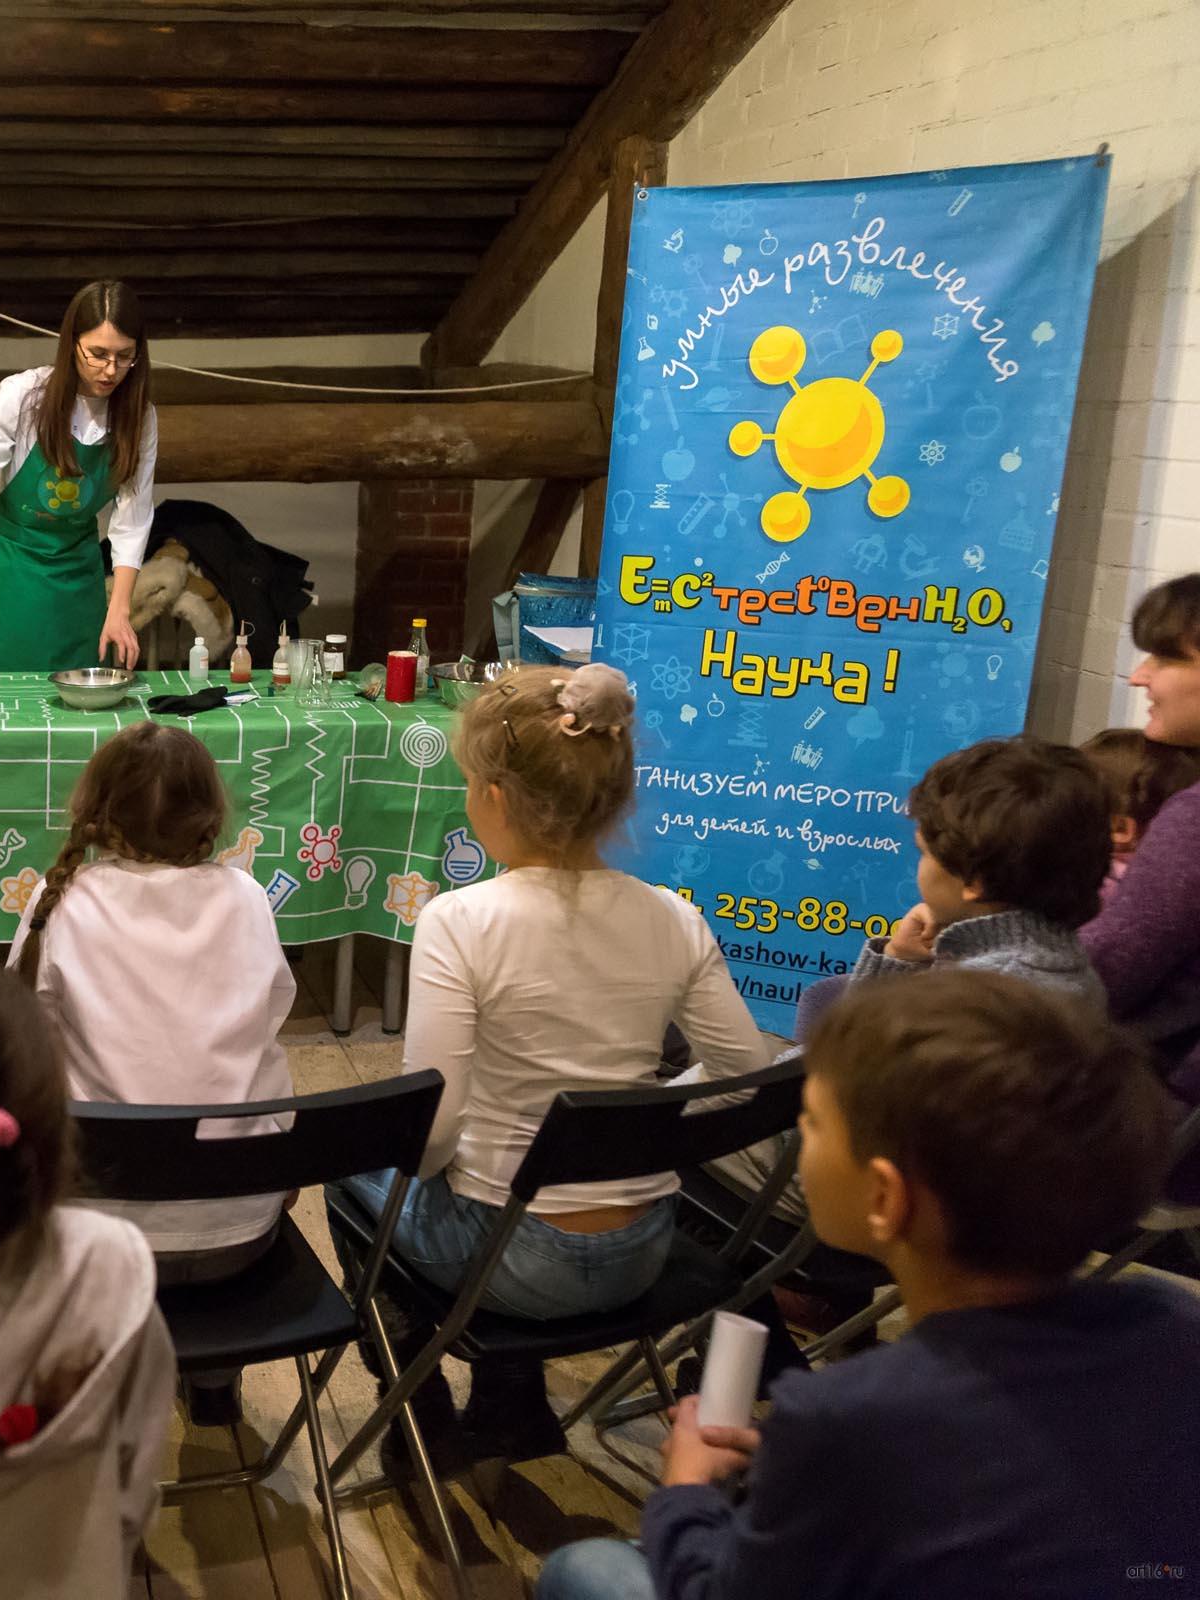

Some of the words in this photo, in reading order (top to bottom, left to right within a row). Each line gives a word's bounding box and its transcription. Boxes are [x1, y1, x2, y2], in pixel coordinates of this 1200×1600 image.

[661, 267, 775, 390] умные
[783, 216, 1020, 383] развлечения
[655, 812, 694, 836] для
[694, 817, 770, 841] детей
[775, 825, 794, 840] и
[797, 818, 902, 855] взрослых
